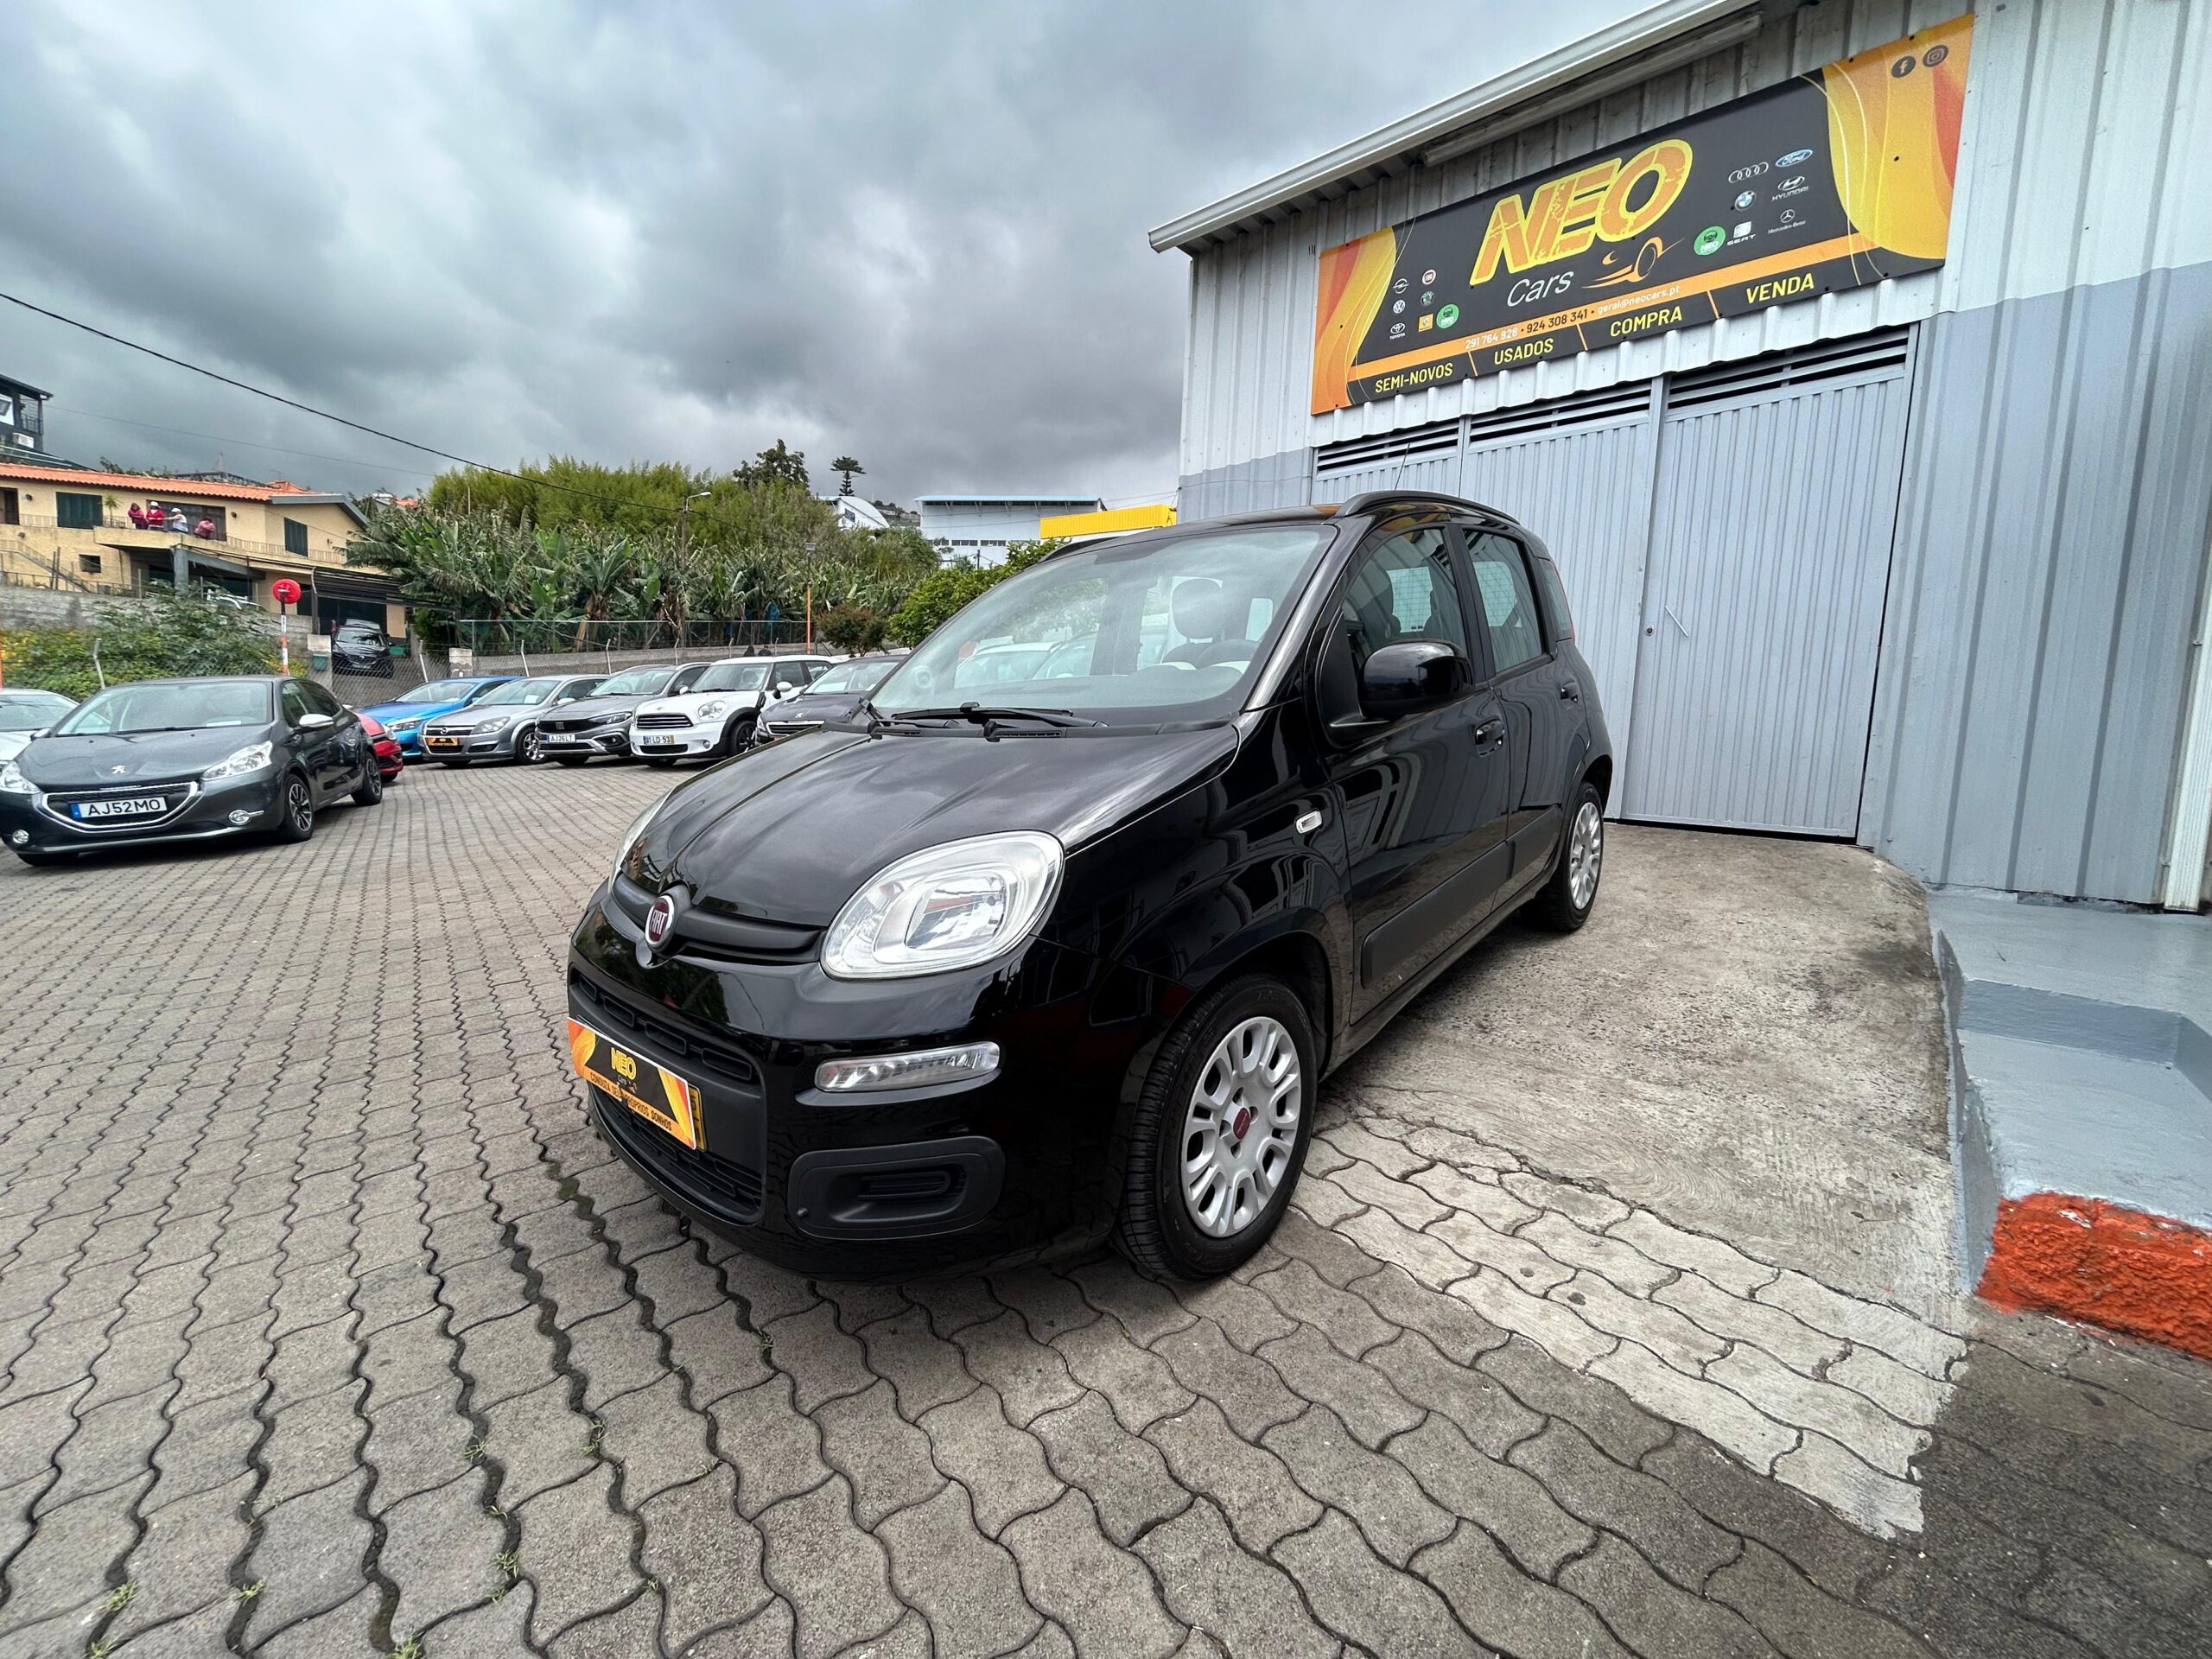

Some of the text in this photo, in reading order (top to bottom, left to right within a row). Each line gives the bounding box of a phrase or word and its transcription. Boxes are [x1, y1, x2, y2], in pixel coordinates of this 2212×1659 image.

[1782, 152, 1806, 165] Ford
[1771, 186, 1809, 201] HYUNDAI
[1469, 139, 1693, 286] NEO
[1726, 234, 1756, 245] SEAT
[1507, 271, 1574, 307] Cars
[1746, 273, 1815, 304] VENDA
[1465, 285, 1681, 349] 291 764 928 924 308 341 geral@neocars.pt
[1610, 306, 1682, 337] COMPRA
[1494, 338, 1554, 365] USADOS
[1375, 363, 1453, 393] SEMI-NOVOS
[88, 799, 161, 816] AJ52MO
[611, 1047, 637, 1080] NEO
[651, 1110, 671, 1131] SONHOS
